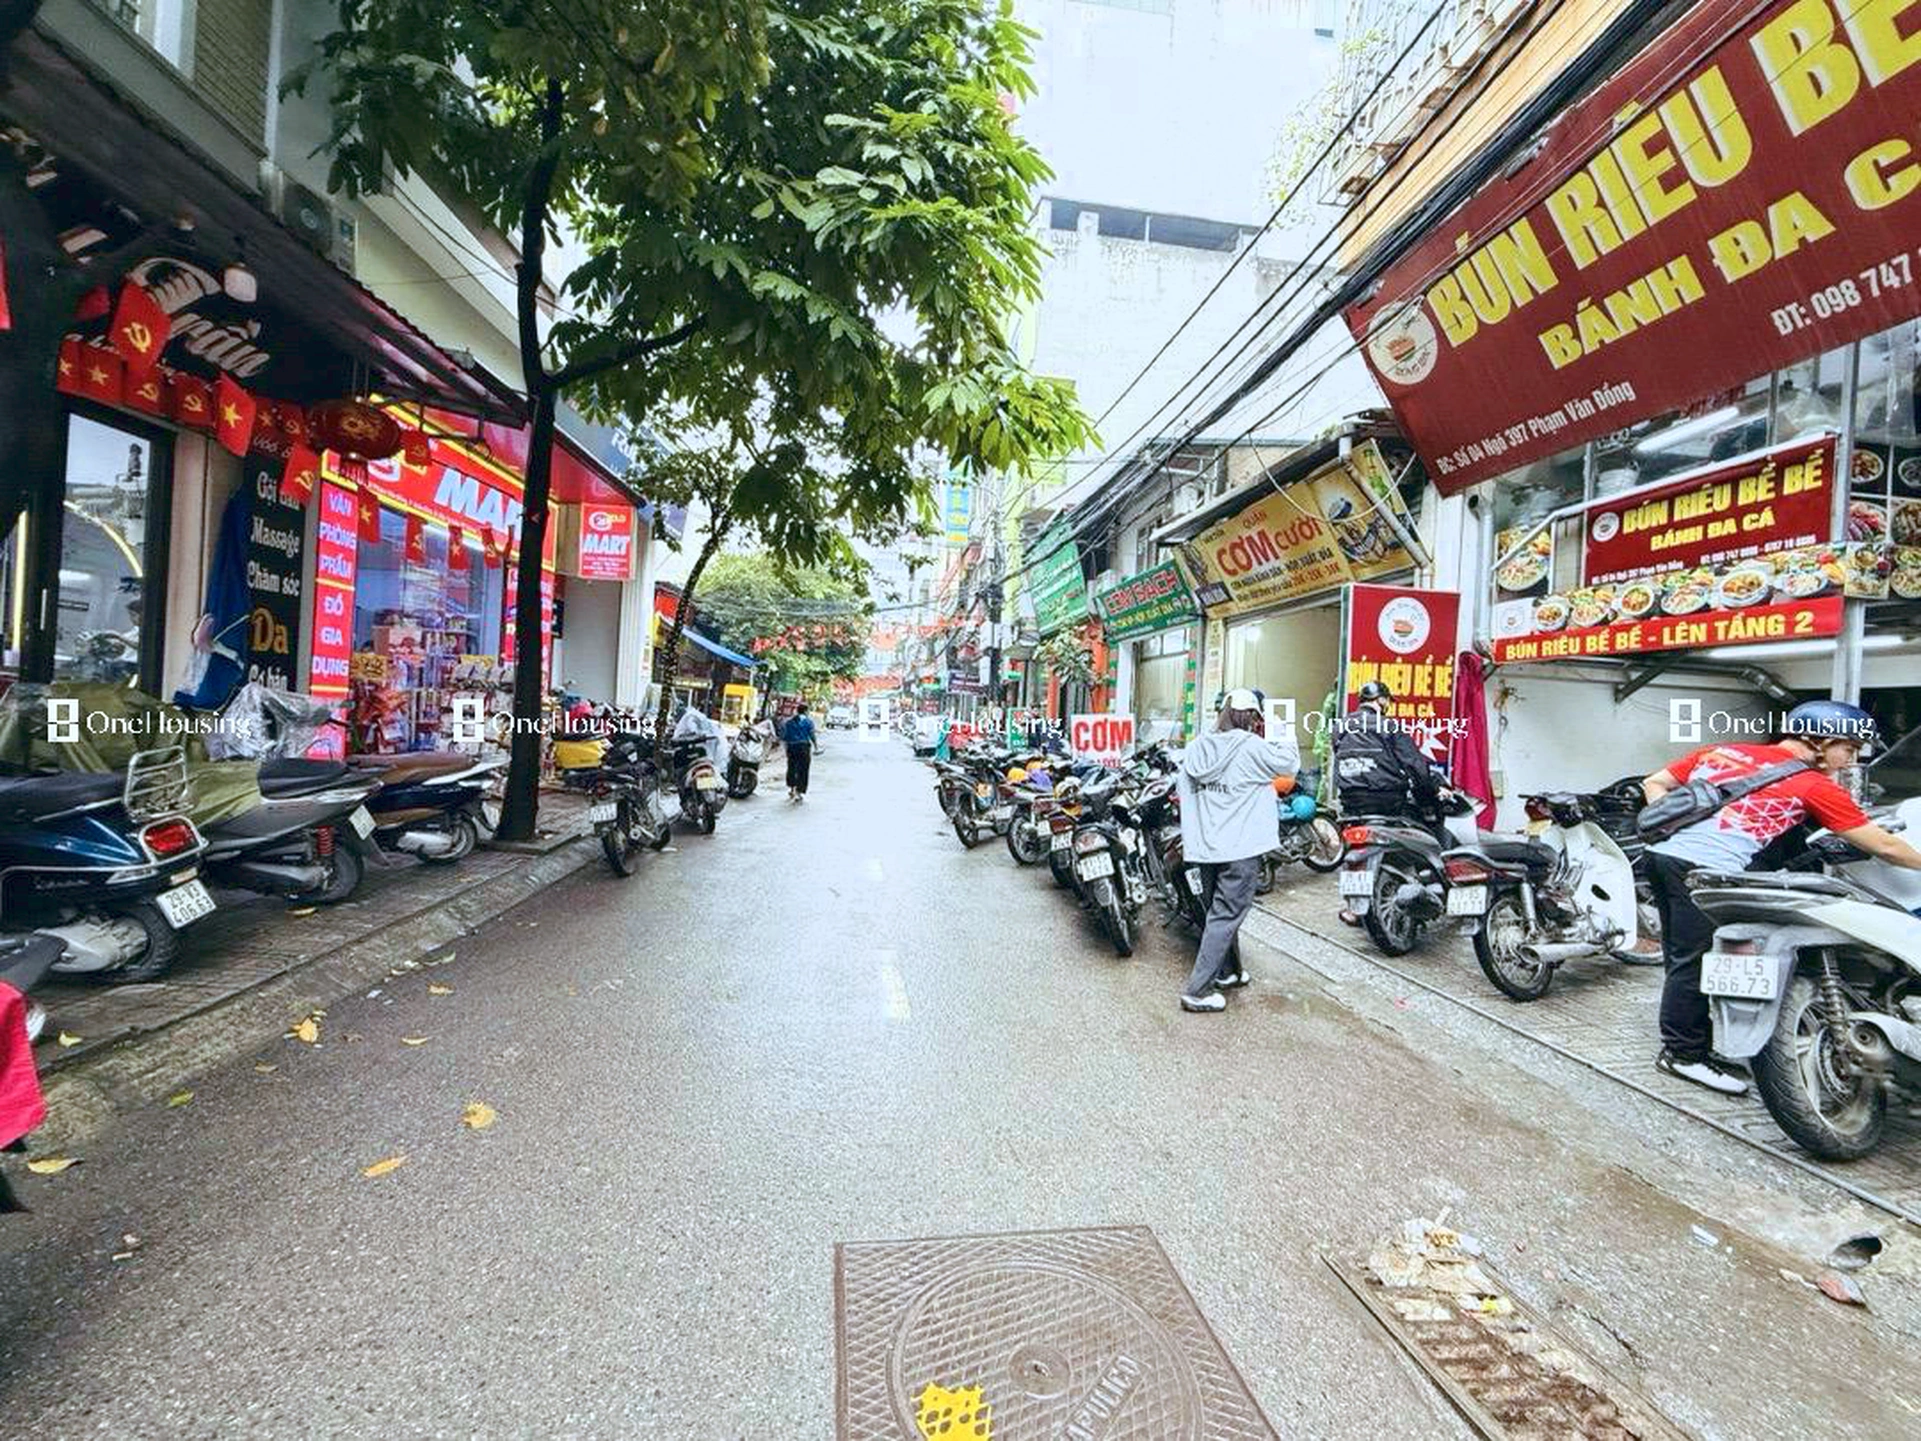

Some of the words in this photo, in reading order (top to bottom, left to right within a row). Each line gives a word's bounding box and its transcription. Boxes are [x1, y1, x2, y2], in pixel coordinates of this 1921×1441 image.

[1426, 231, 1558, 348] BÚN
[1538, 254, 1706, 370] BÁNH
[1708, 190, 1835, 284] ĐA
[1771, 302, 1812, 336] ĐT:
[1810, 279, 1862, 318] 098
[1859, 253, 1913, 297] 747
[1504, 424, 1530, 447] 397
[1528, 410, 1568, 438] Phạm
[1564, 398, 1596, 421] Văn
[1623, 499, 1669, 535] BÚN
[1673, 483, 1732, 522] RIÊU
[250, 516, 300, 558] Massage
[582, 533, 631, 556] MART
[1217, 529, 1280, 577] CƠM
[251, 607, 290, 655] Da
[321, 626, 343, 646] GIA
[1505, 639, 1538, 661] BÚN
[1541, 632, 1581, 657] RIÊU
[1662, 621, 1708, 647] LÊN
[1794, 611, 1814, 634] 2
[312, 655, 350, 679] DỤNG
[1074, 718, 1133, 752] CƠM
[1706, 974, 1771, 995] 566.73
